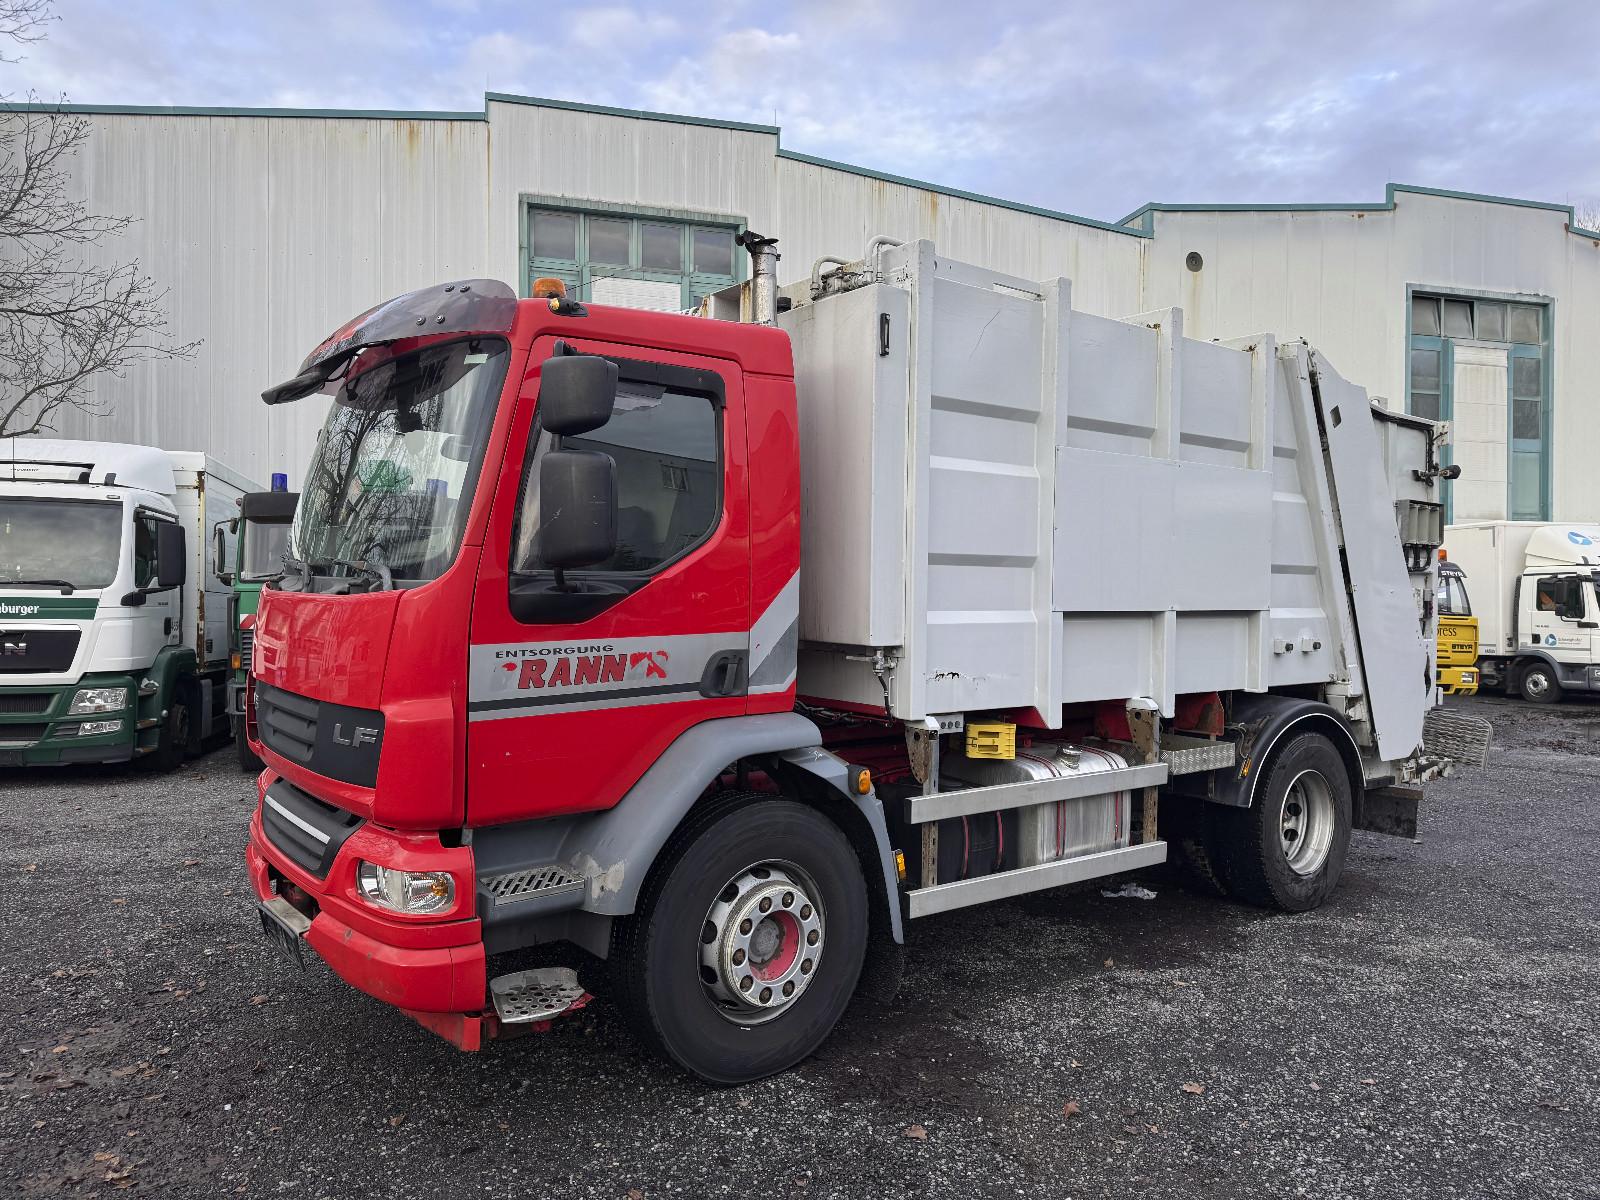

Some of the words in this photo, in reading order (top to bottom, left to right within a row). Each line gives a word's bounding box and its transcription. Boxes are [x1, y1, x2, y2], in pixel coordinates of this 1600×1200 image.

[0, 602, 40, 616] burger
[495, 644, 614, 659] ENTSORGUNG
[332, 723, 379, 748] LF
